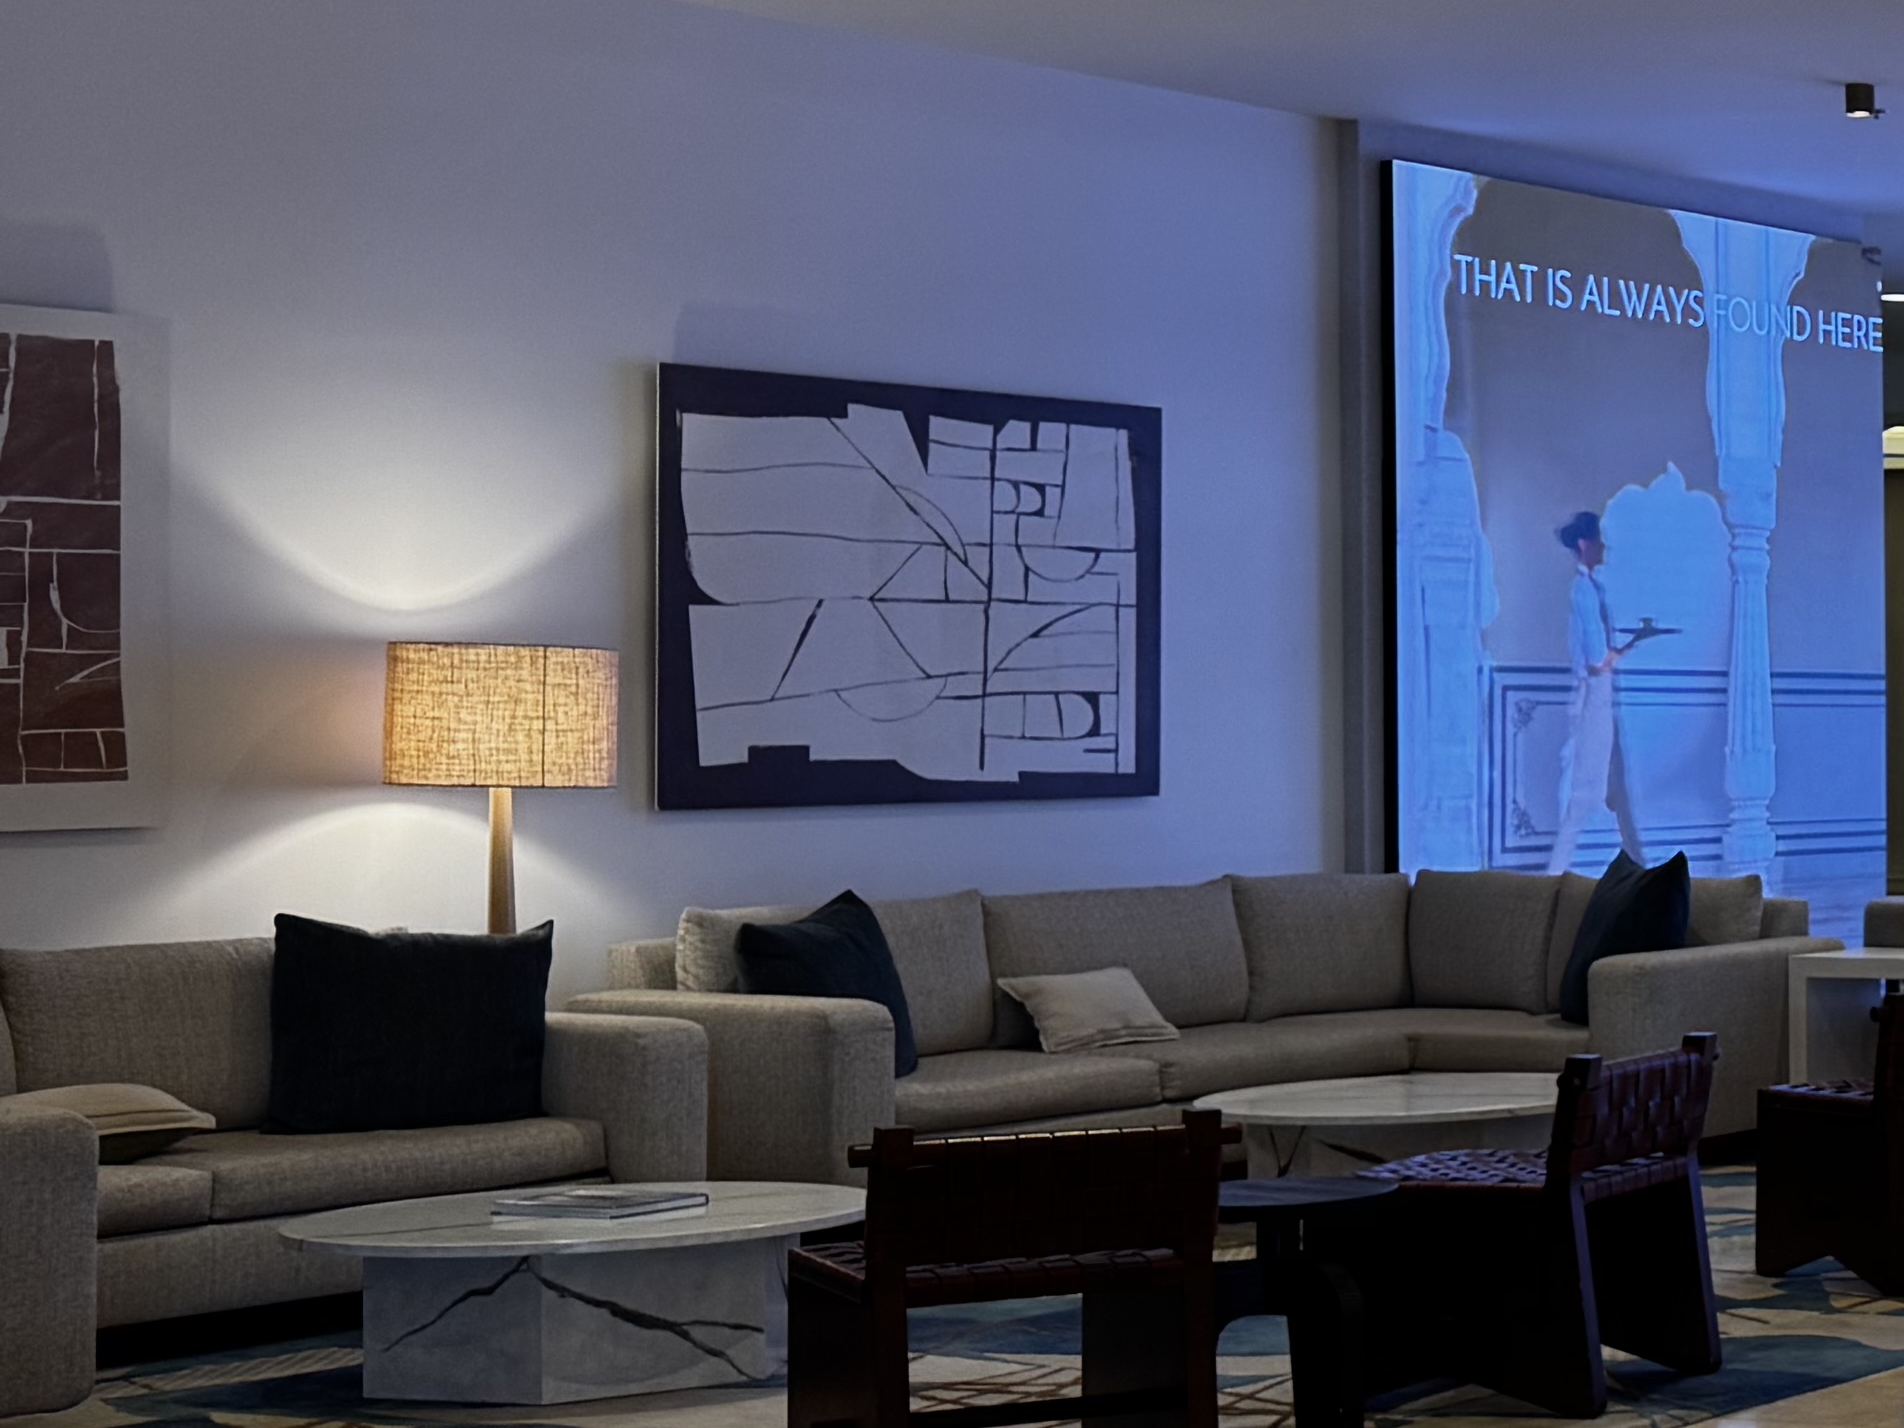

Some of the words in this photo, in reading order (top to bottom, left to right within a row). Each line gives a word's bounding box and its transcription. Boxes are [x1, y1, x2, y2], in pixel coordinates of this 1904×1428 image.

[1454, 254, 1538, 303] THAT
[1547, 268, 1573, 309] IS
[1580, 274, 1705, 328] ALWAYS
[1714, 294, 1811, 342] FOUND
[1818, 311, 1883, 353] HERE
